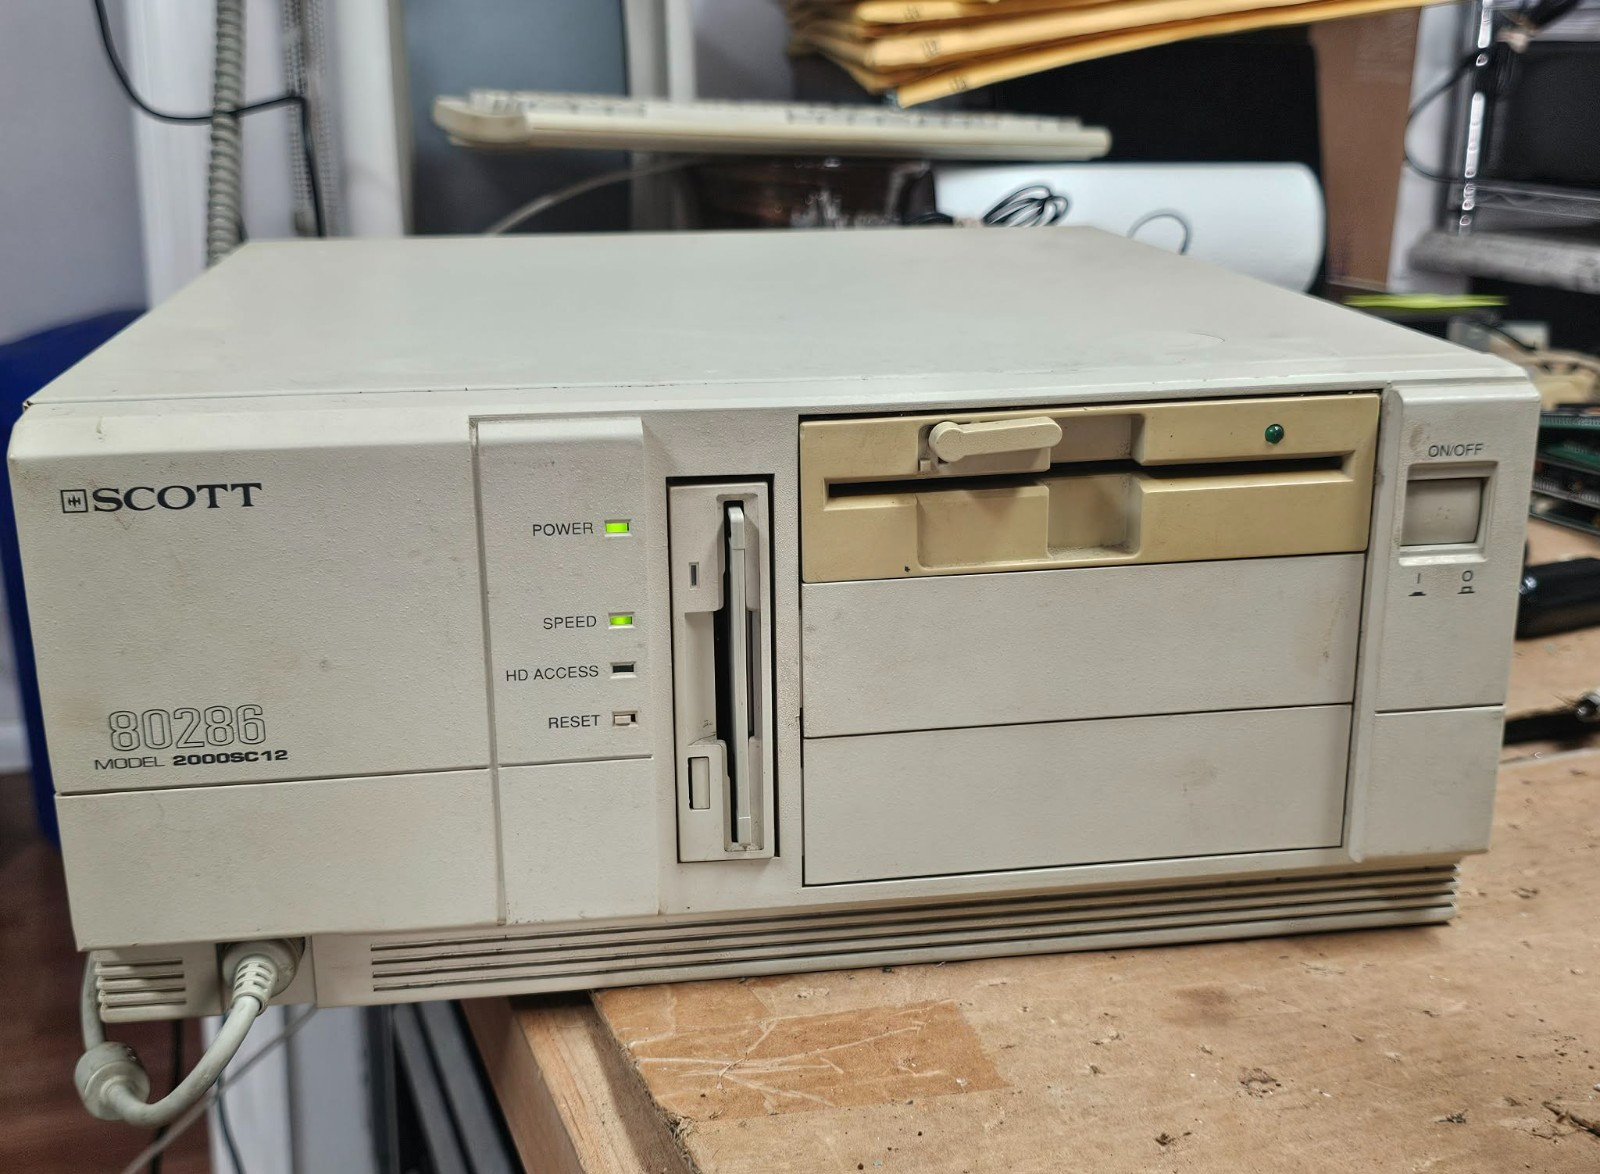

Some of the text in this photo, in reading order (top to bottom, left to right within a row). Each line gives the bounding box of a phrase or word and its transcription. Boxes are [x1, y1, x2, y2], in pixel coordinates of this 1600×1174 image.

[1428, 443, 1484, 457] ON/OFF
[92, 482, 262, 512] SCOTT
[532, 522, 594, 536] POWER
[543, 615, 597, 629] SPEED
[506, 665, 599, 681] HD ACCESS
[109, 704, 266, 751] 80286
[548, 714, 600, 729] RESET
[94, 750, 289, 770] MODEL 2000SC12
